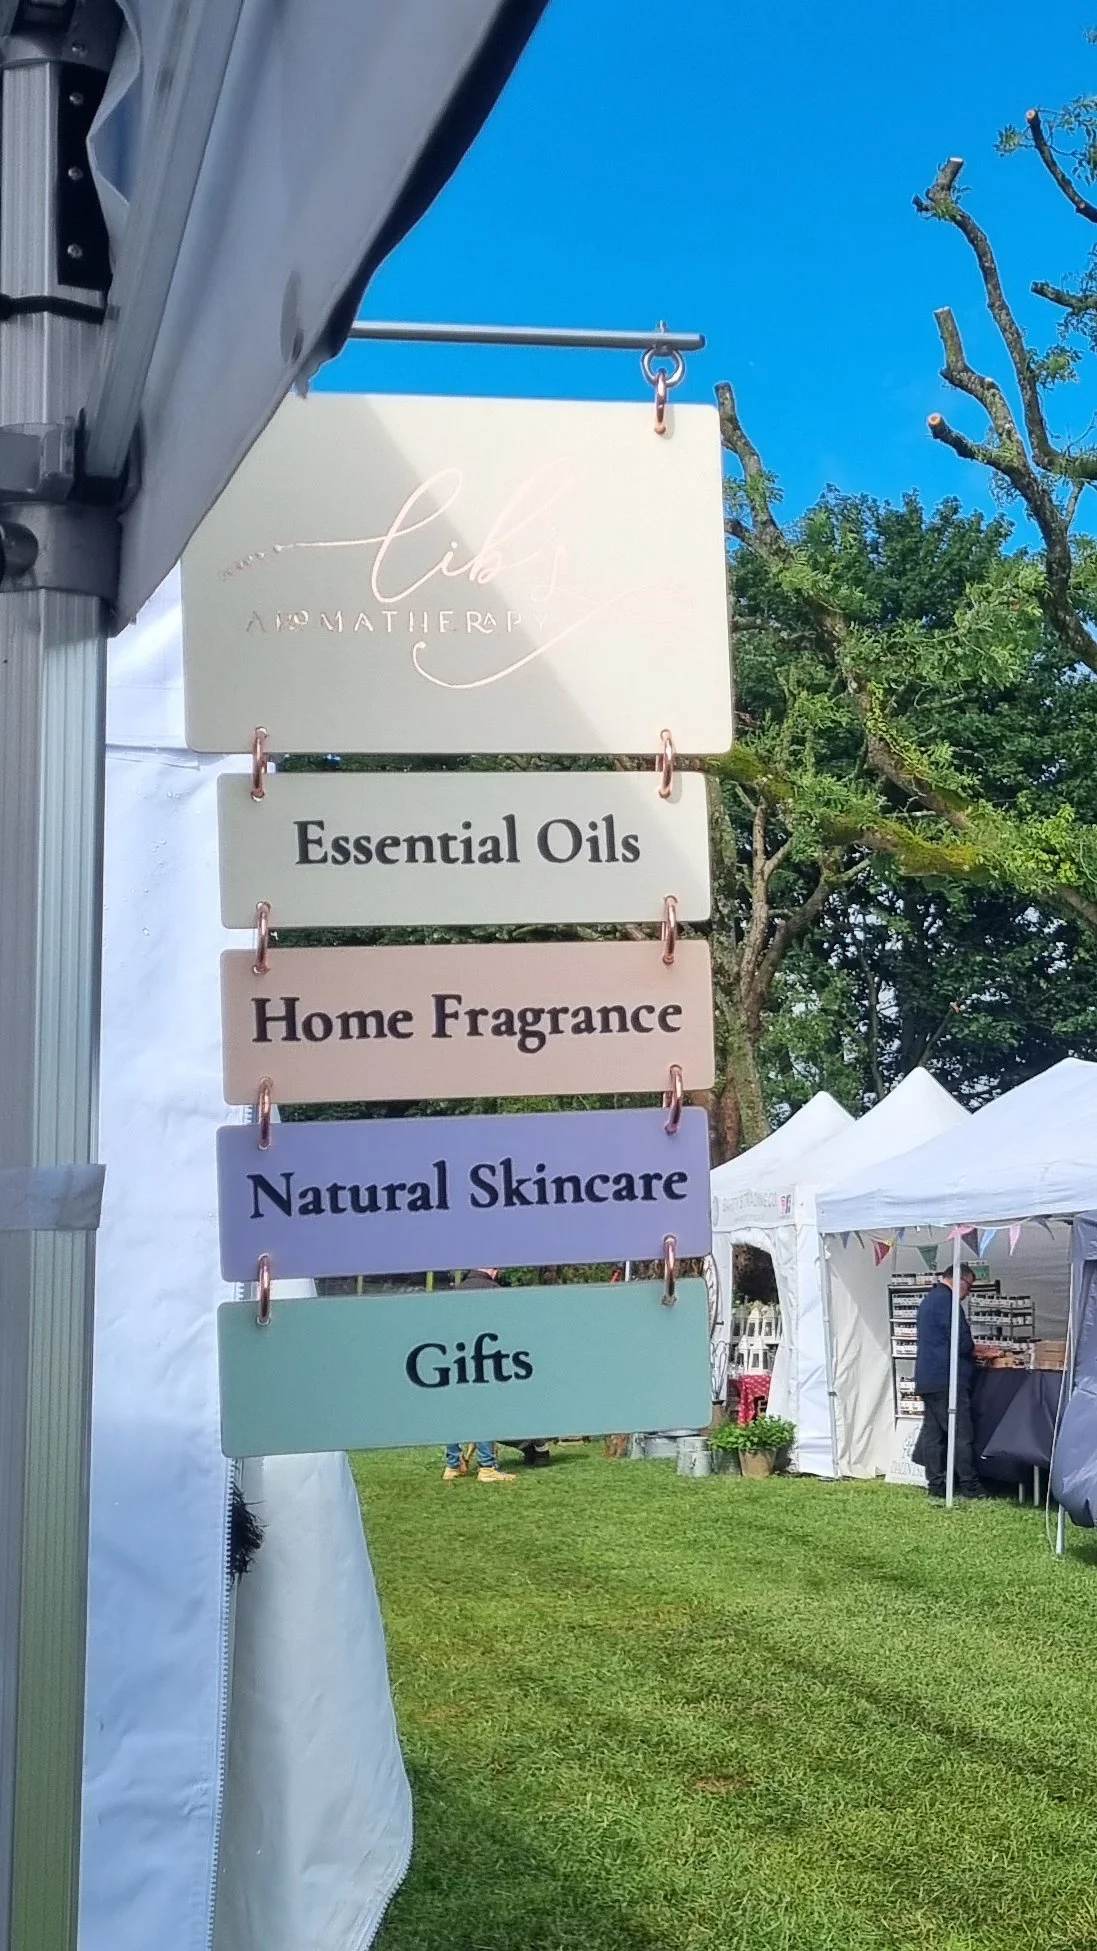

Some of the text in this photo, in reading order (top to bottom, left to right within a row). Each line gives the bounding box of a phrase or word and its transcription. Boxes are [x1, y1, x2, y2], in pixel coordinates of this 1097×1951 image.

[245, 609, 548, 635] AROMATHERAPY
[293, 813, 641, 865] Essential Oils
[251, 993, 683, 1054] Home Fragrance
[246, 1157, 688, 1219] Natural Skincare
[405, 1332, 534, 1388] Gifts
